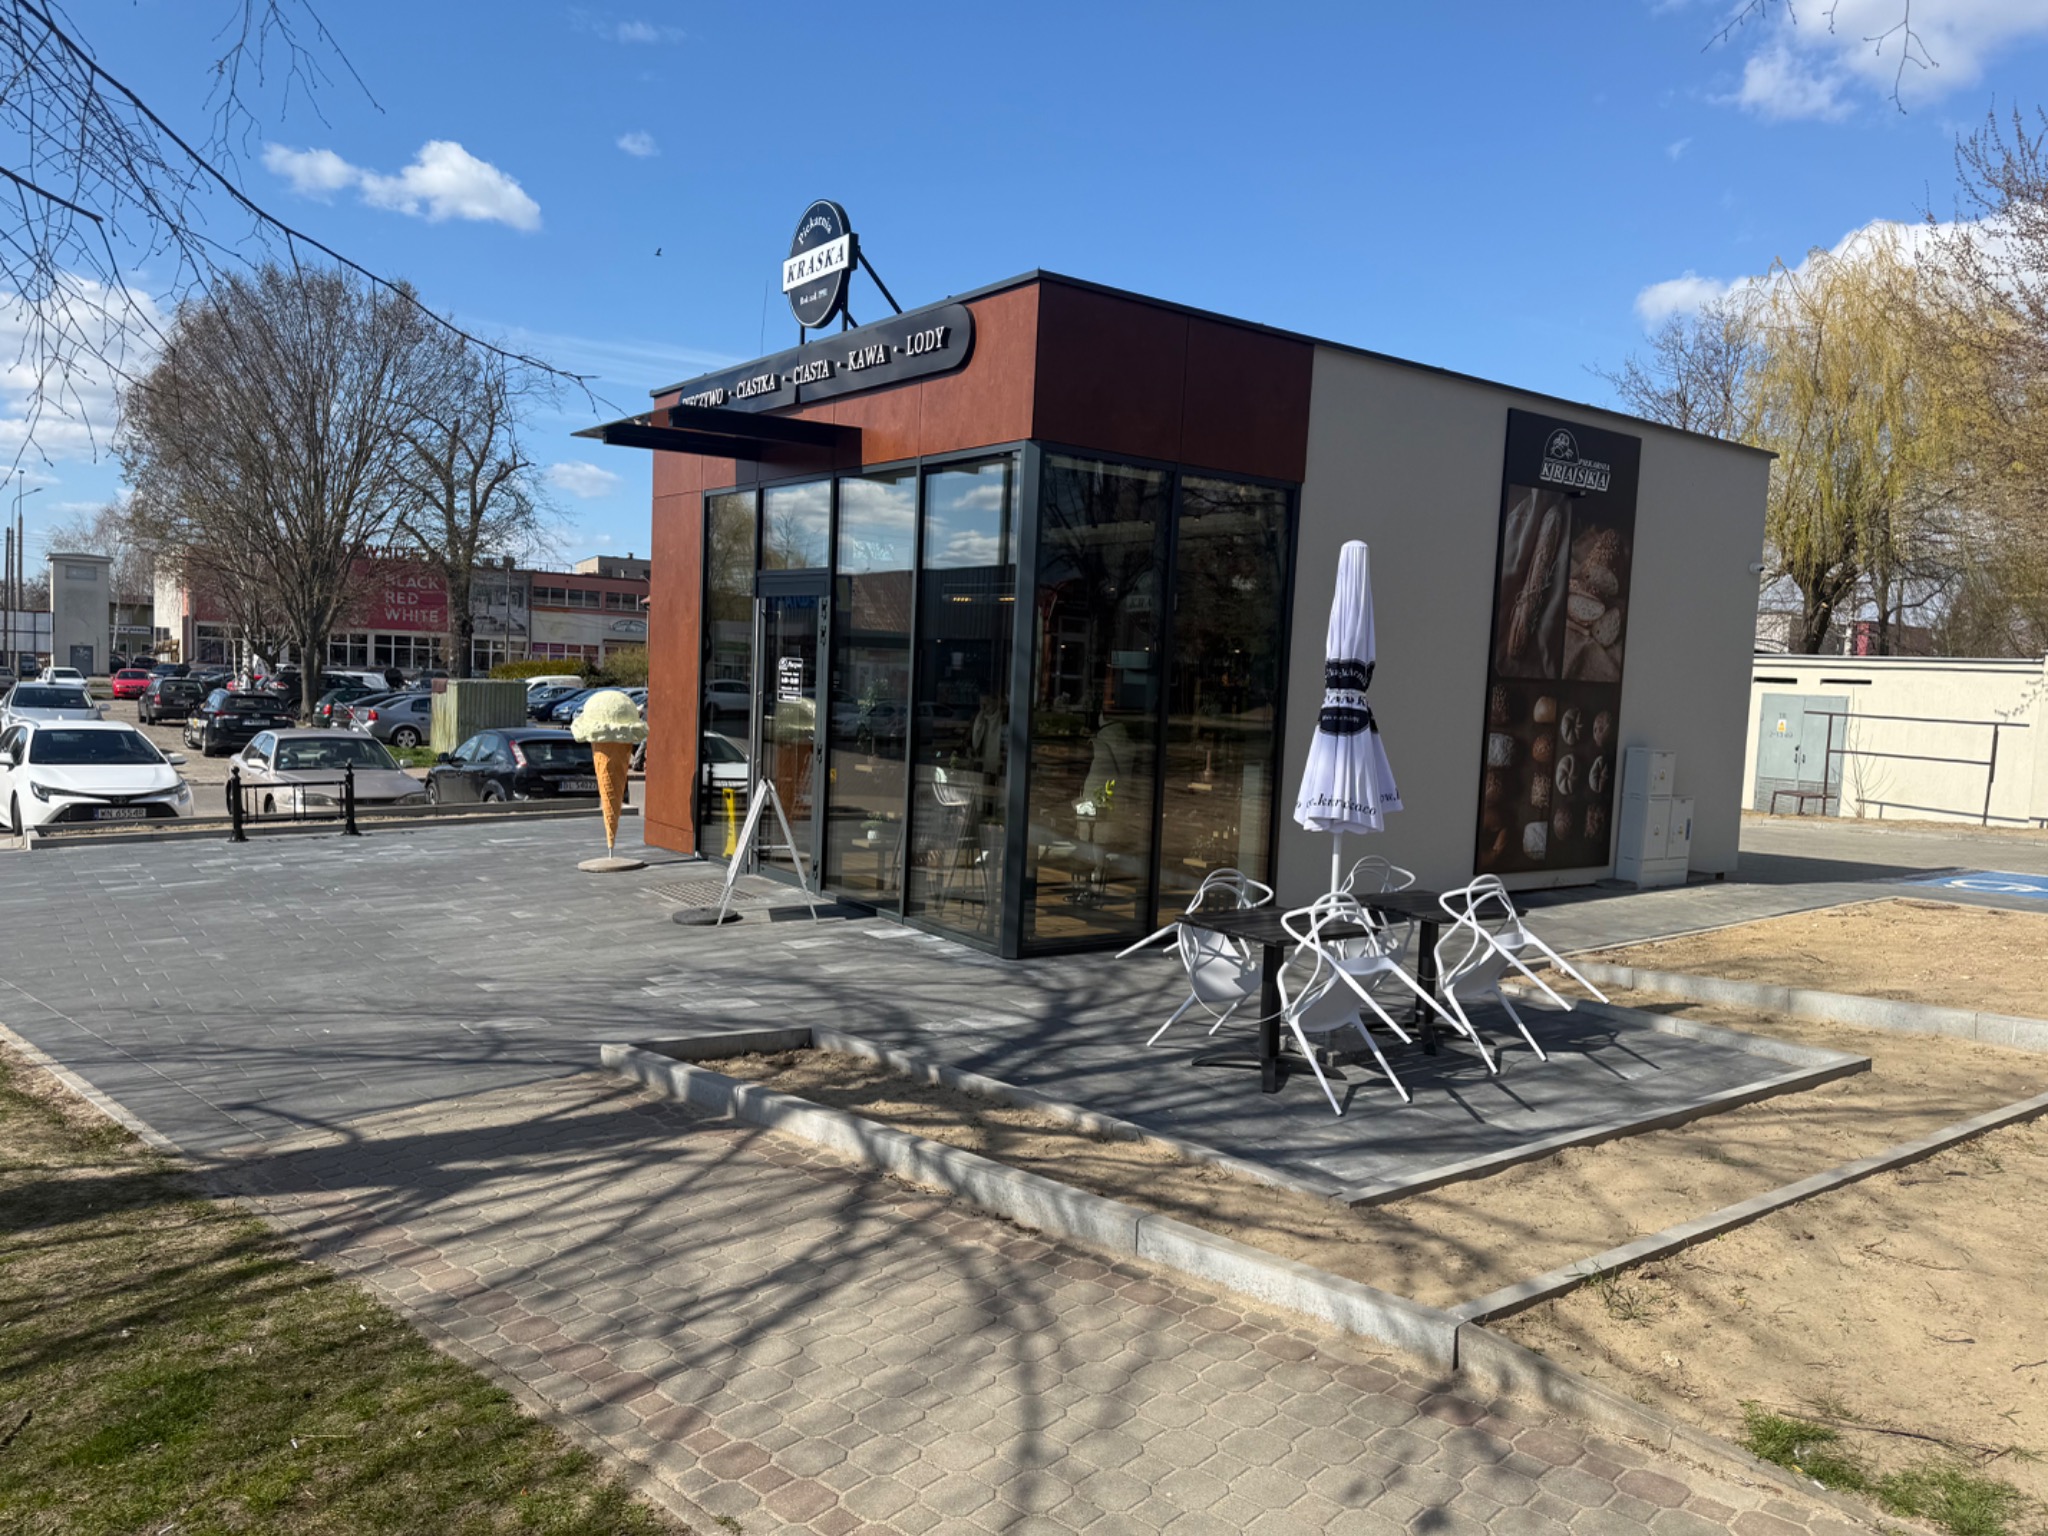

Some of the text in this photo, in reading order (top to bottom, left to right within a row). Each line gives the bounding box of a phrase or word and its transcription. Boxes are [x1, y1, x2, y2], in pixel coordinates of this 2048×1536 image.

[786, 242, 845, 284] KRASKA
[736, 373, 776, 399] CIASTKA
[793, 359, 830, 385] CIASTA
[847, 343, 886, 371] KAWA
[906, 326, 945, 356] LODY
[1541, 462, 1608, 488] KRASKA
[385, 575, 439, 590] BLACK
[385, 591, 419, 605] RED
[384, 607, 439, 623] WHITE
